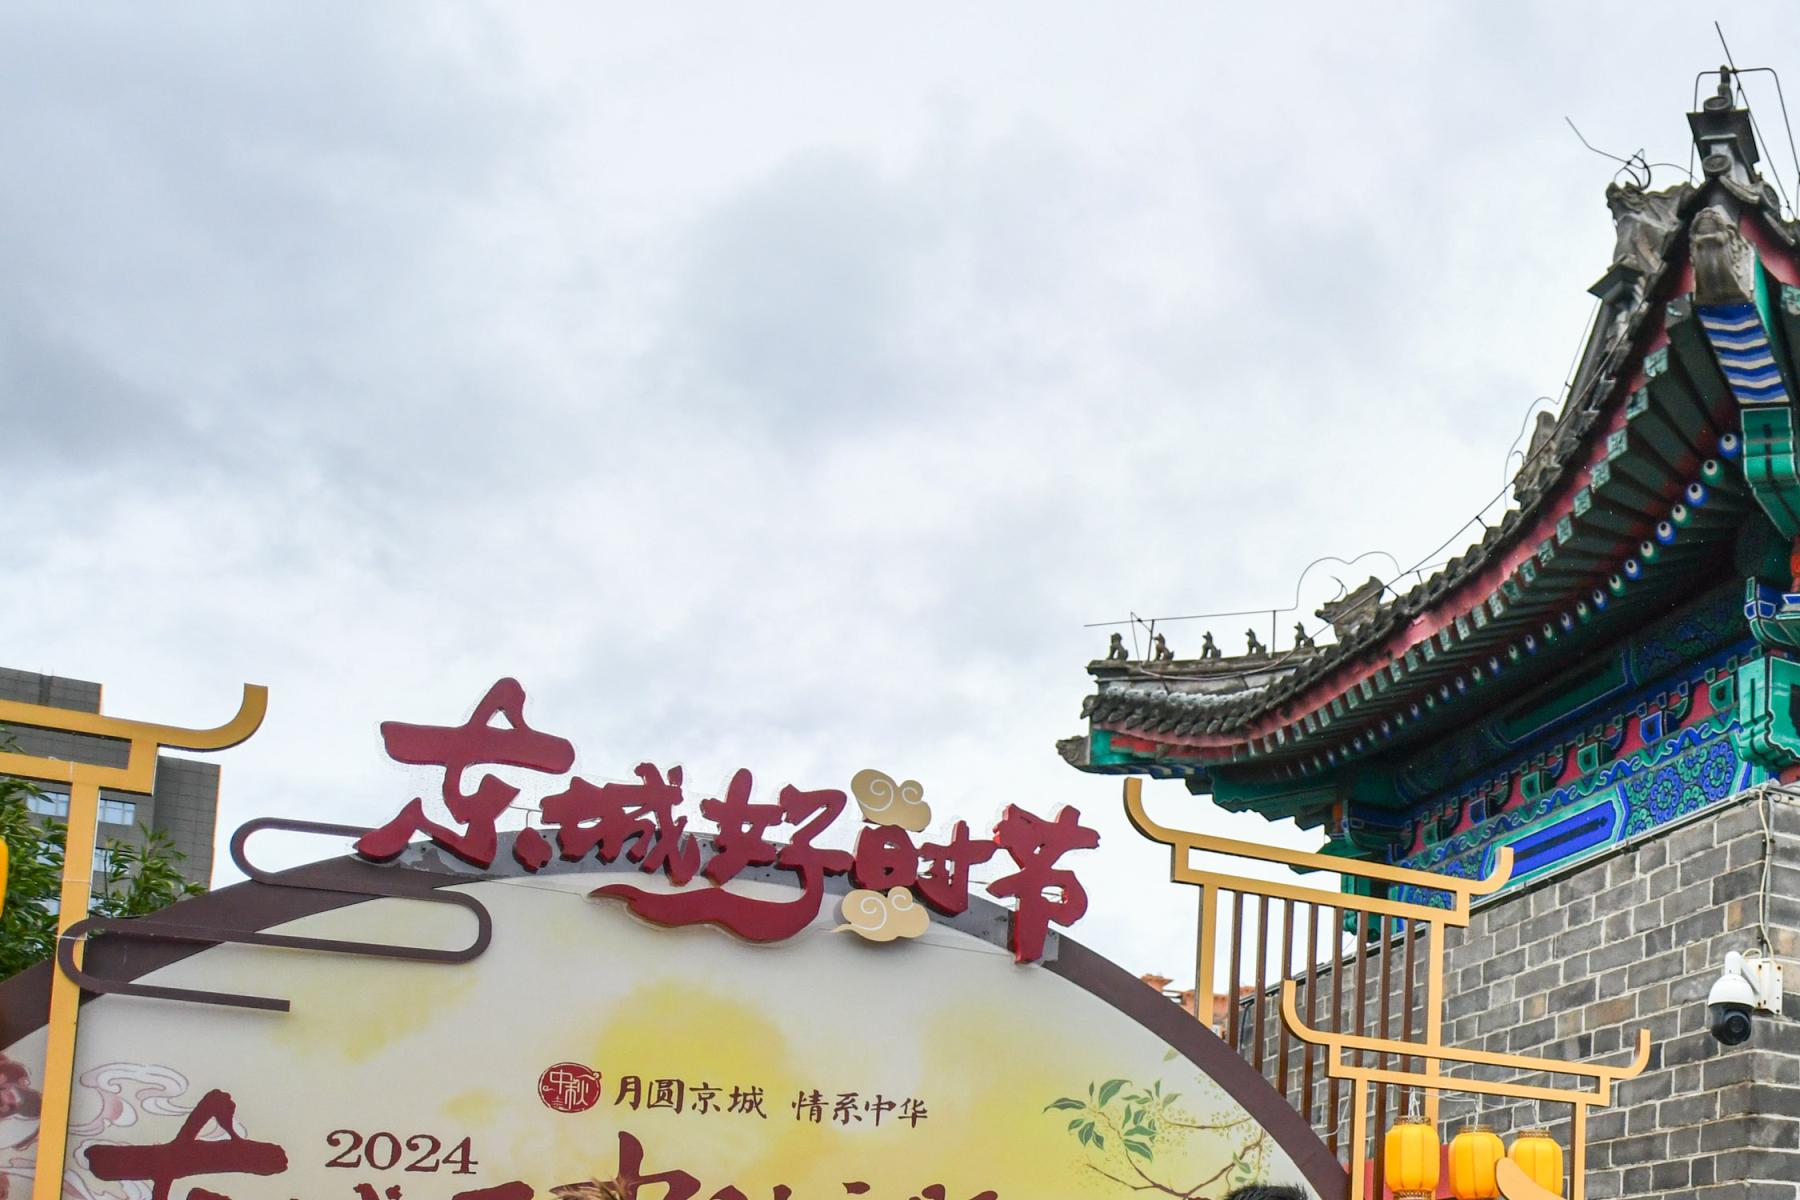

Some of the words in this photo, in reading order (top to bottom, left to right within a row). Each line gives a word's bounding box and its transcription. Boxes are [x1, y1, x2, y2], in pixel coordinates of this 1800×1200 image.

[613, 1074, 768, 1120] 月圆京城
[790, 1089, 929, 1129] 情系中华
[325, 1129, 479, 1175] 2024
